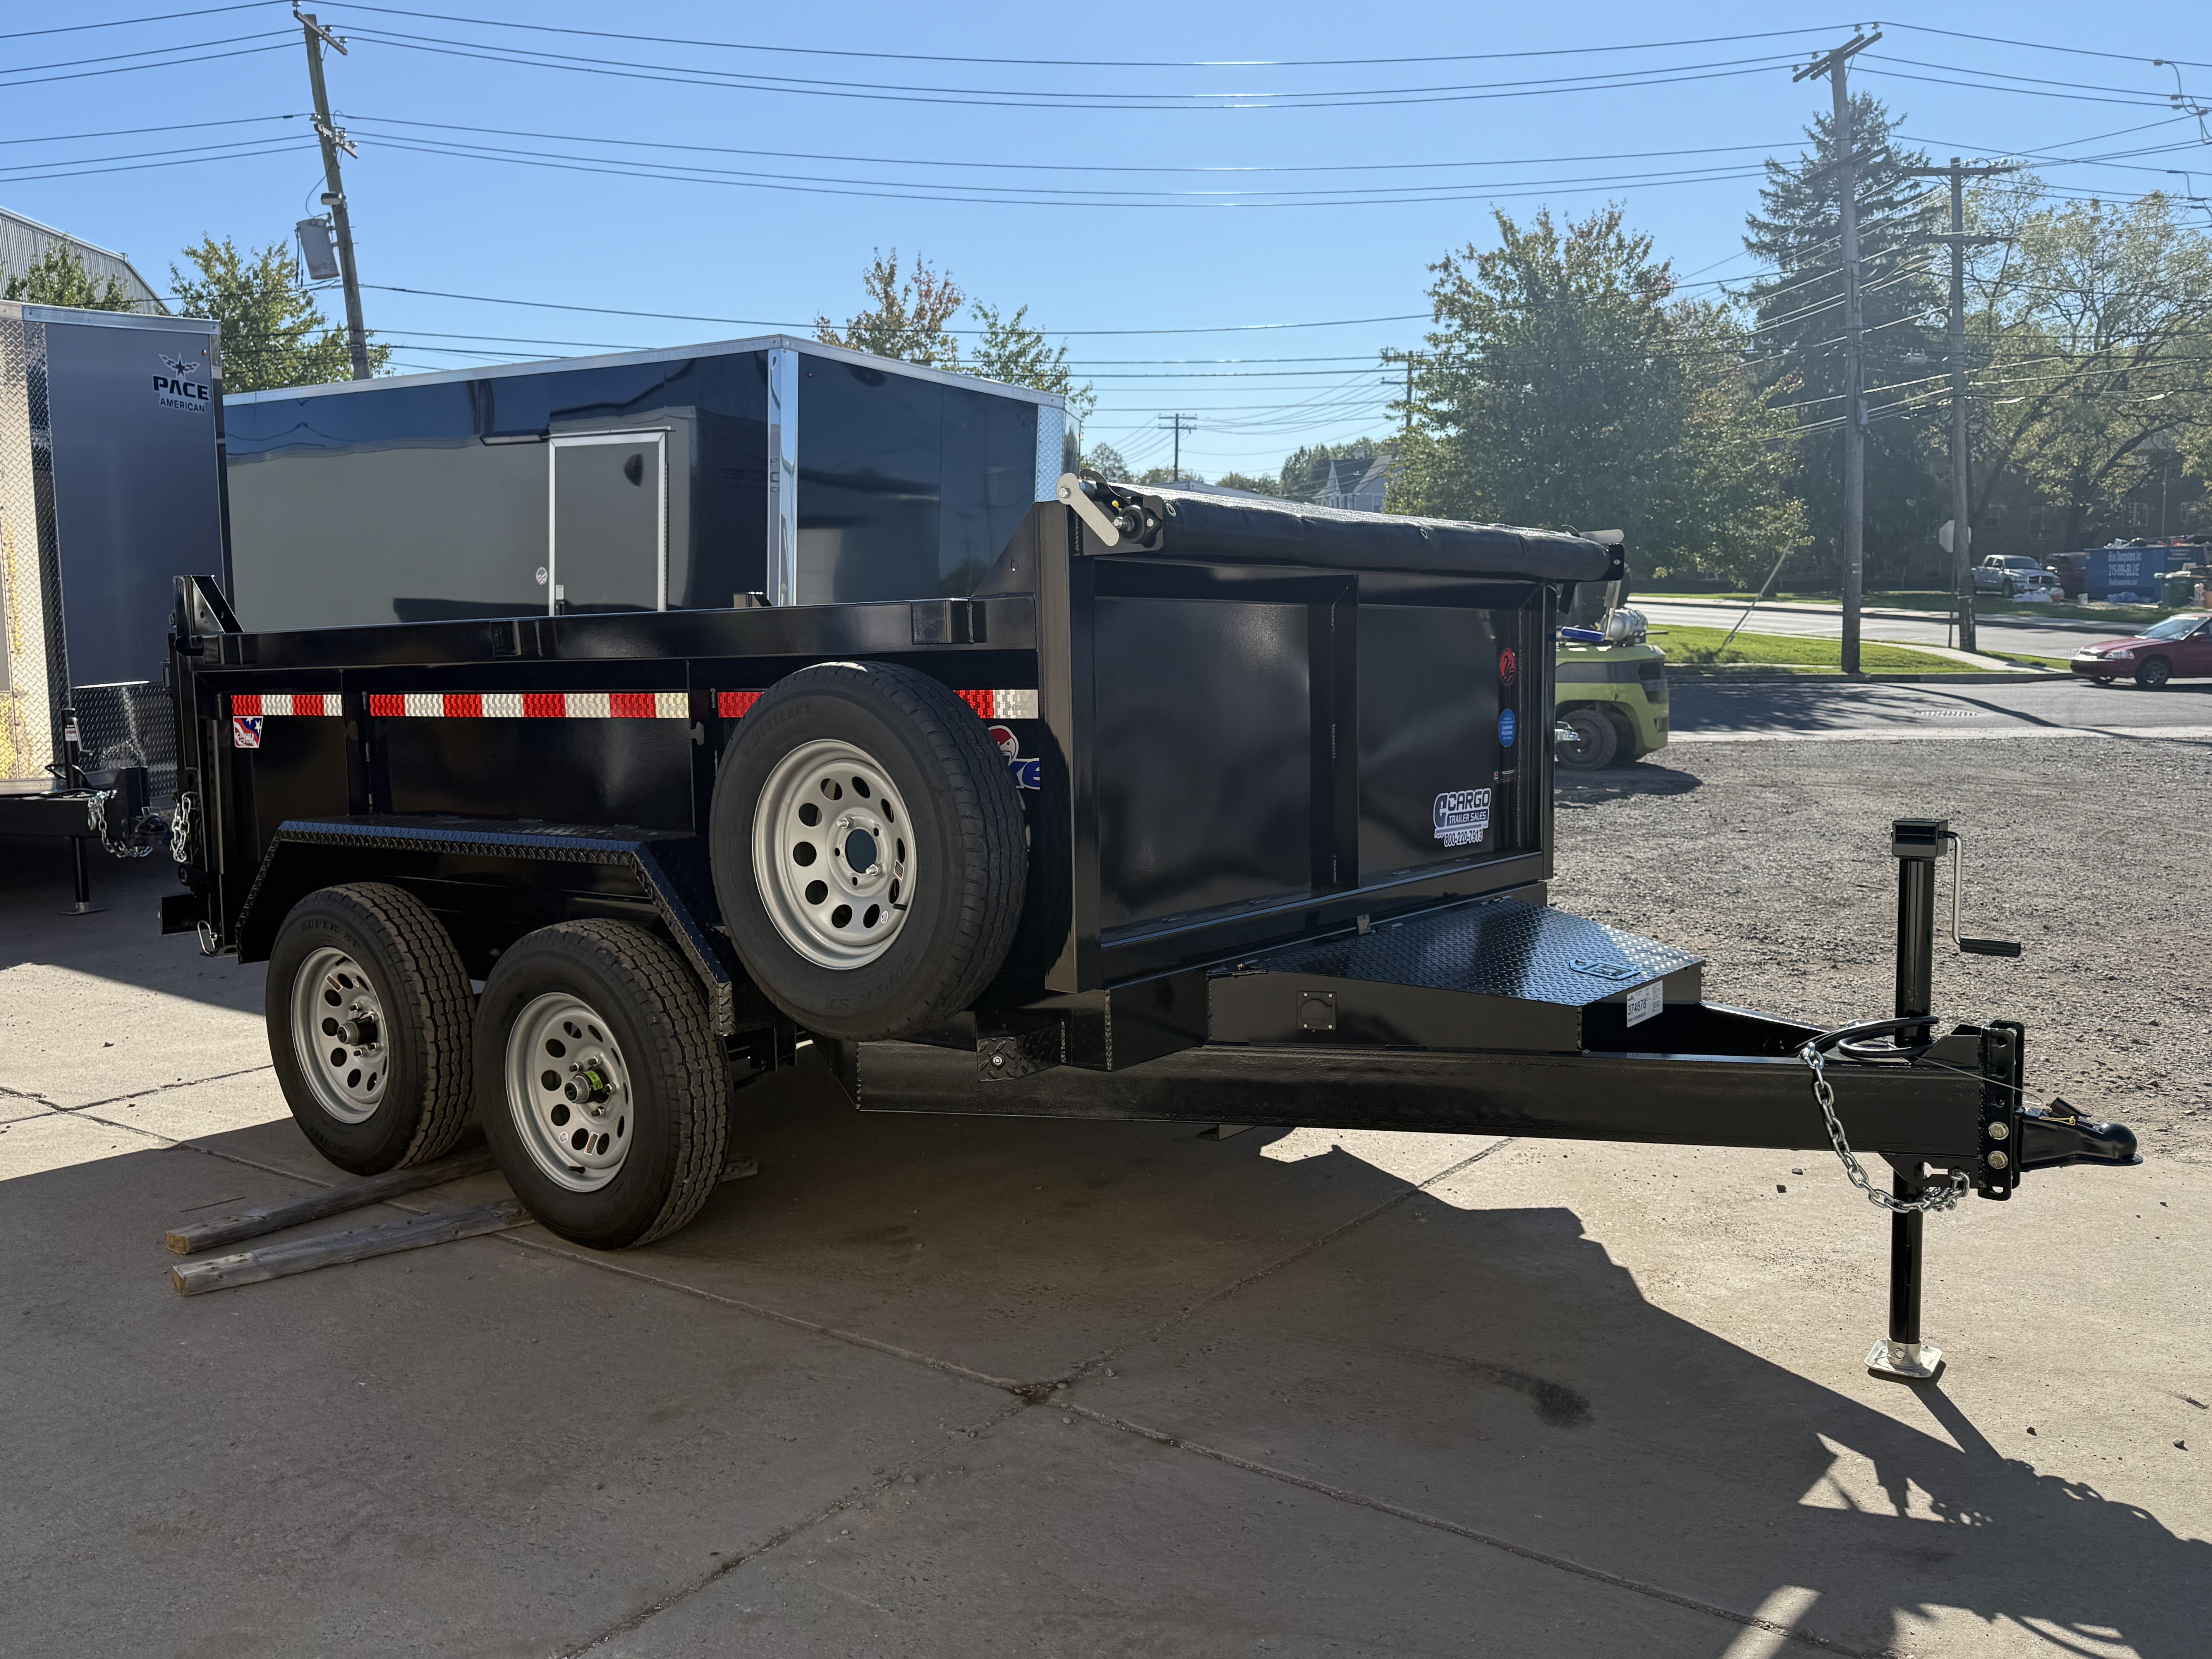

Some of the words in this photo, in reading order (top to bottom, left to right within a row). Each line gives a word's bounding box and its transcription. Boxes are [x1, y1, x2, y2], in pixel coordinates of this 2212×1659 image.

[153, 376, 209, 400] PACE
[160, 398, 204, 412] AMERICAN
[751, 703, 811, 749] WESTLAKE
[1448, 789, 1491, 812] CARGO
[1449, 813, 1470, 824] TRAILER
[1470, 811, 1486, 821] SALES
[1445, 829, 1482, 845] 800-220-7913
[301, 919, 339, 933] SUPER
